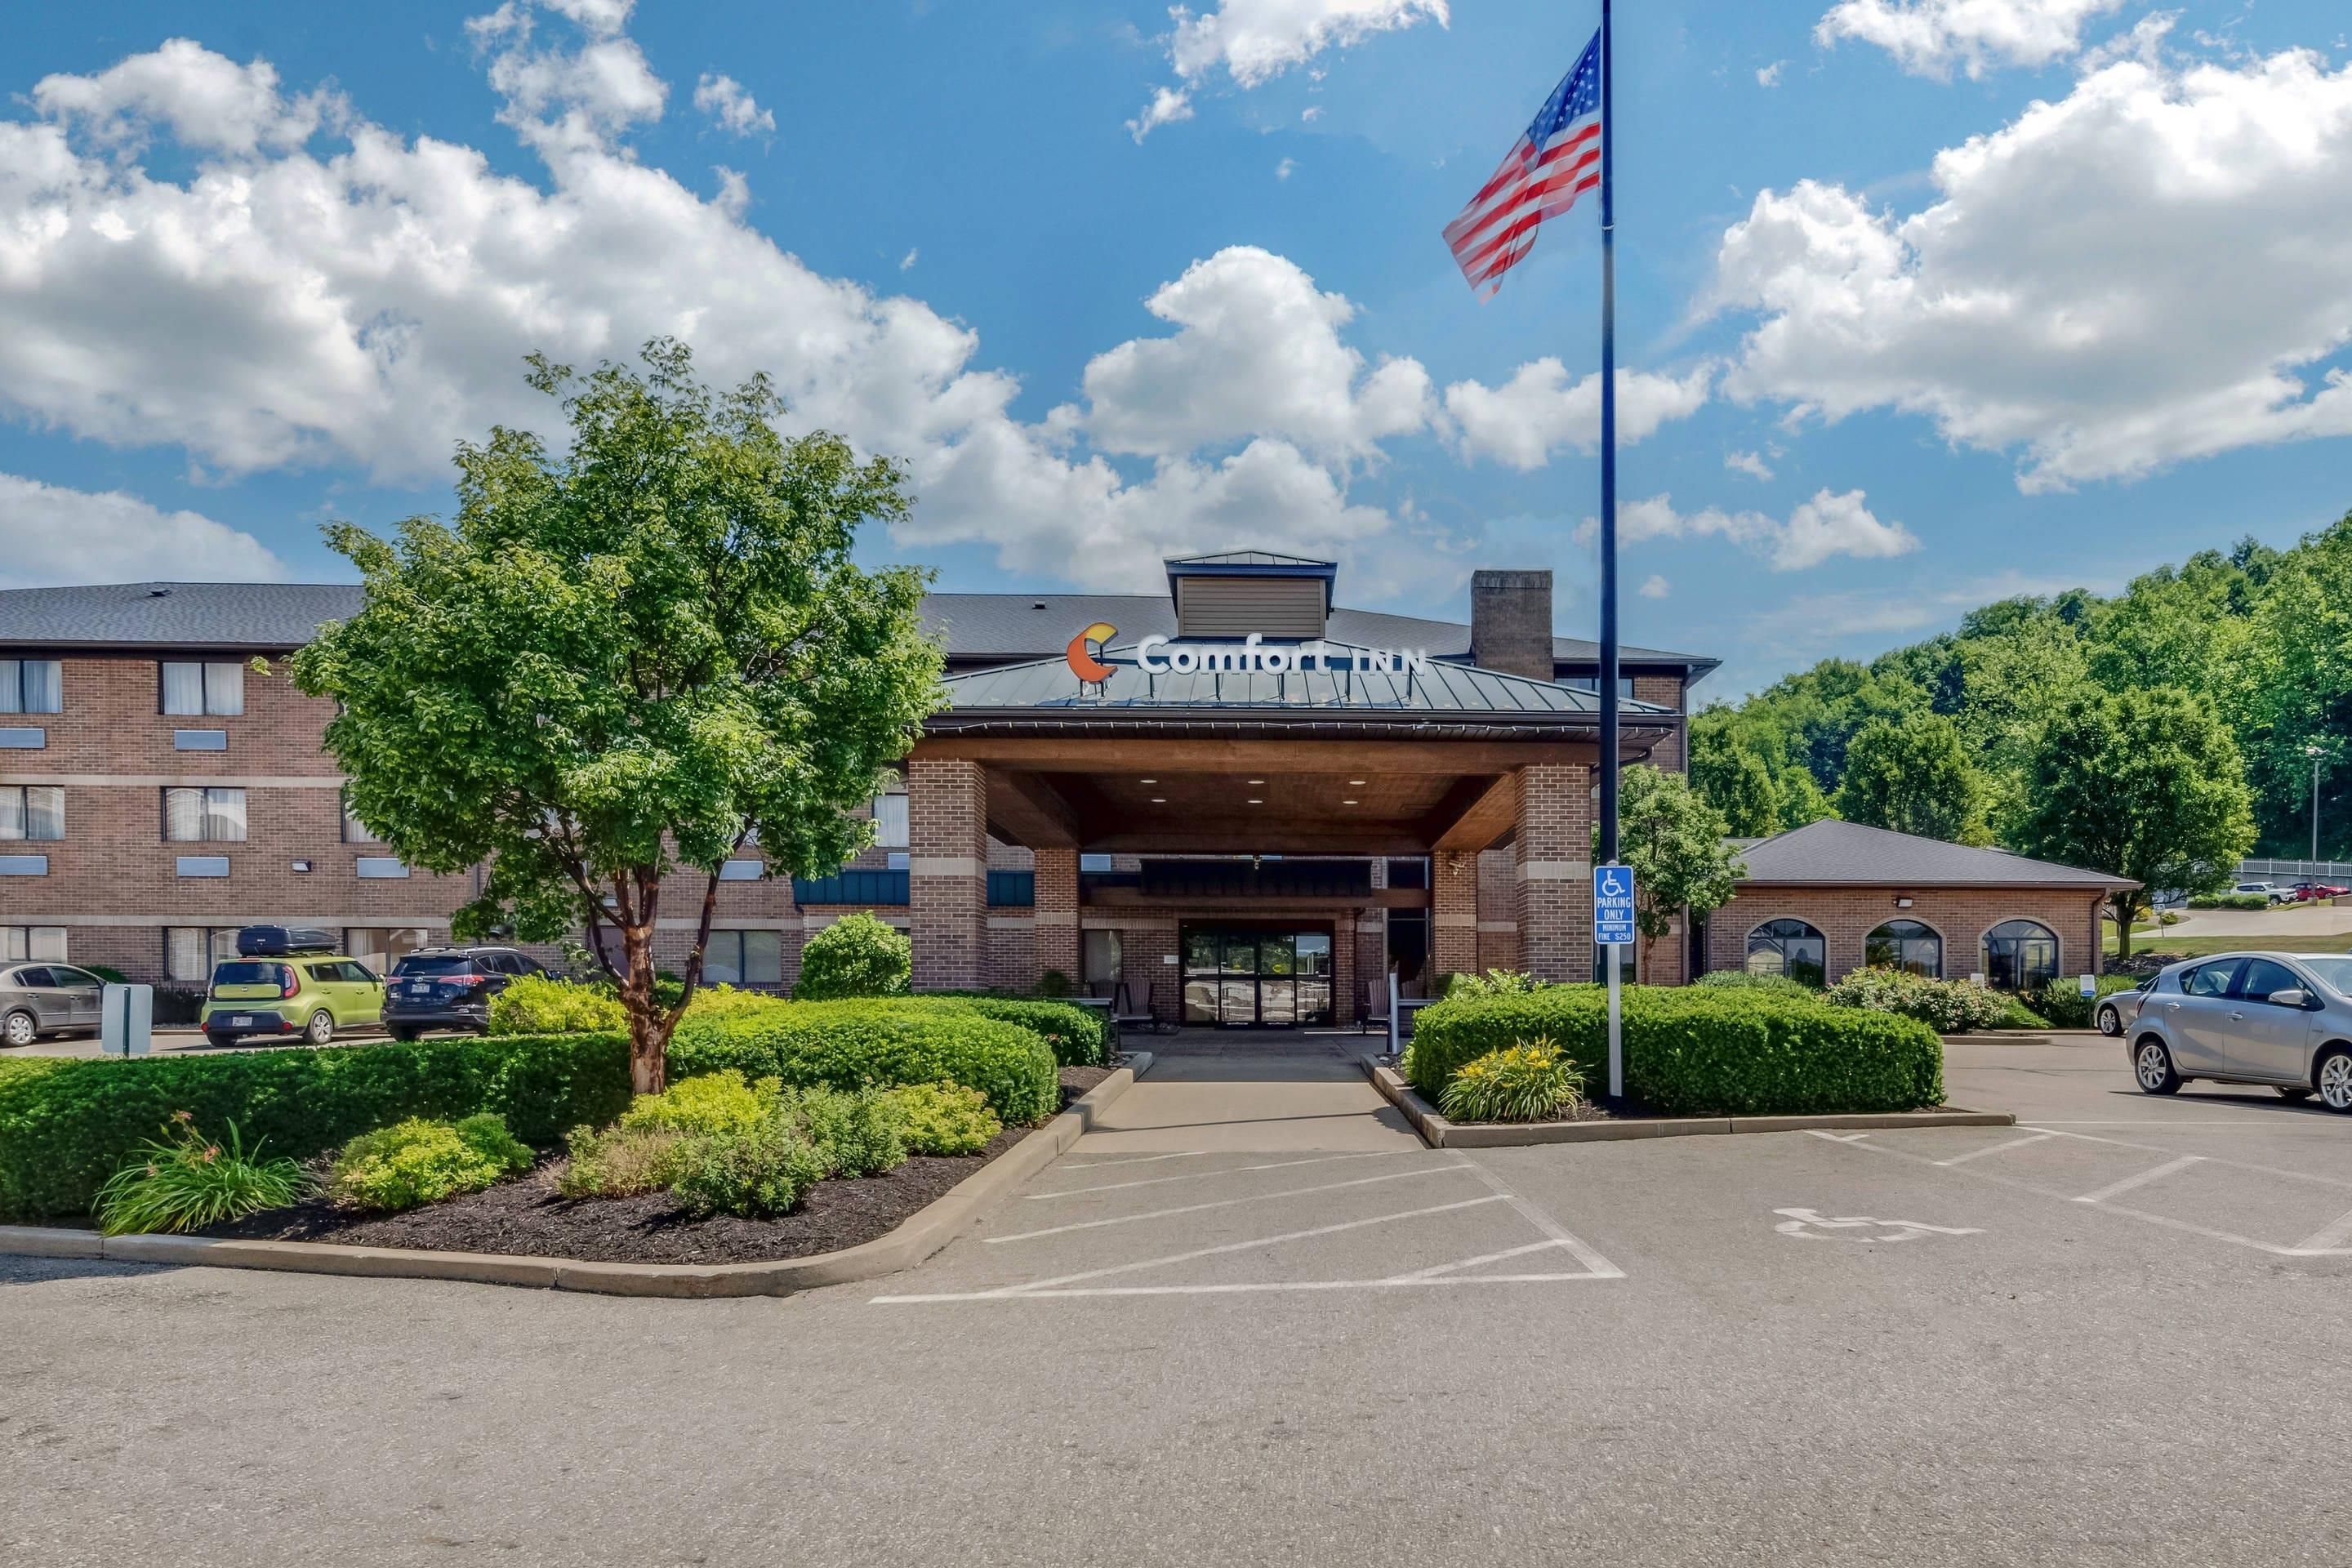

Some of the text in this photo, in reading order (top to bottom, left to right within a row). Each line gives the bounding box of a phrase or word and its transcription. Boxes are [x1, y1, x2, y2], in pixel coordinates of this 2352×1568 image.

[1137, 633, 1427, 677] Comfort INN
[1597, 897, 1631, 908] PARKING
[1604, 909, 1624, 920] ONLY
